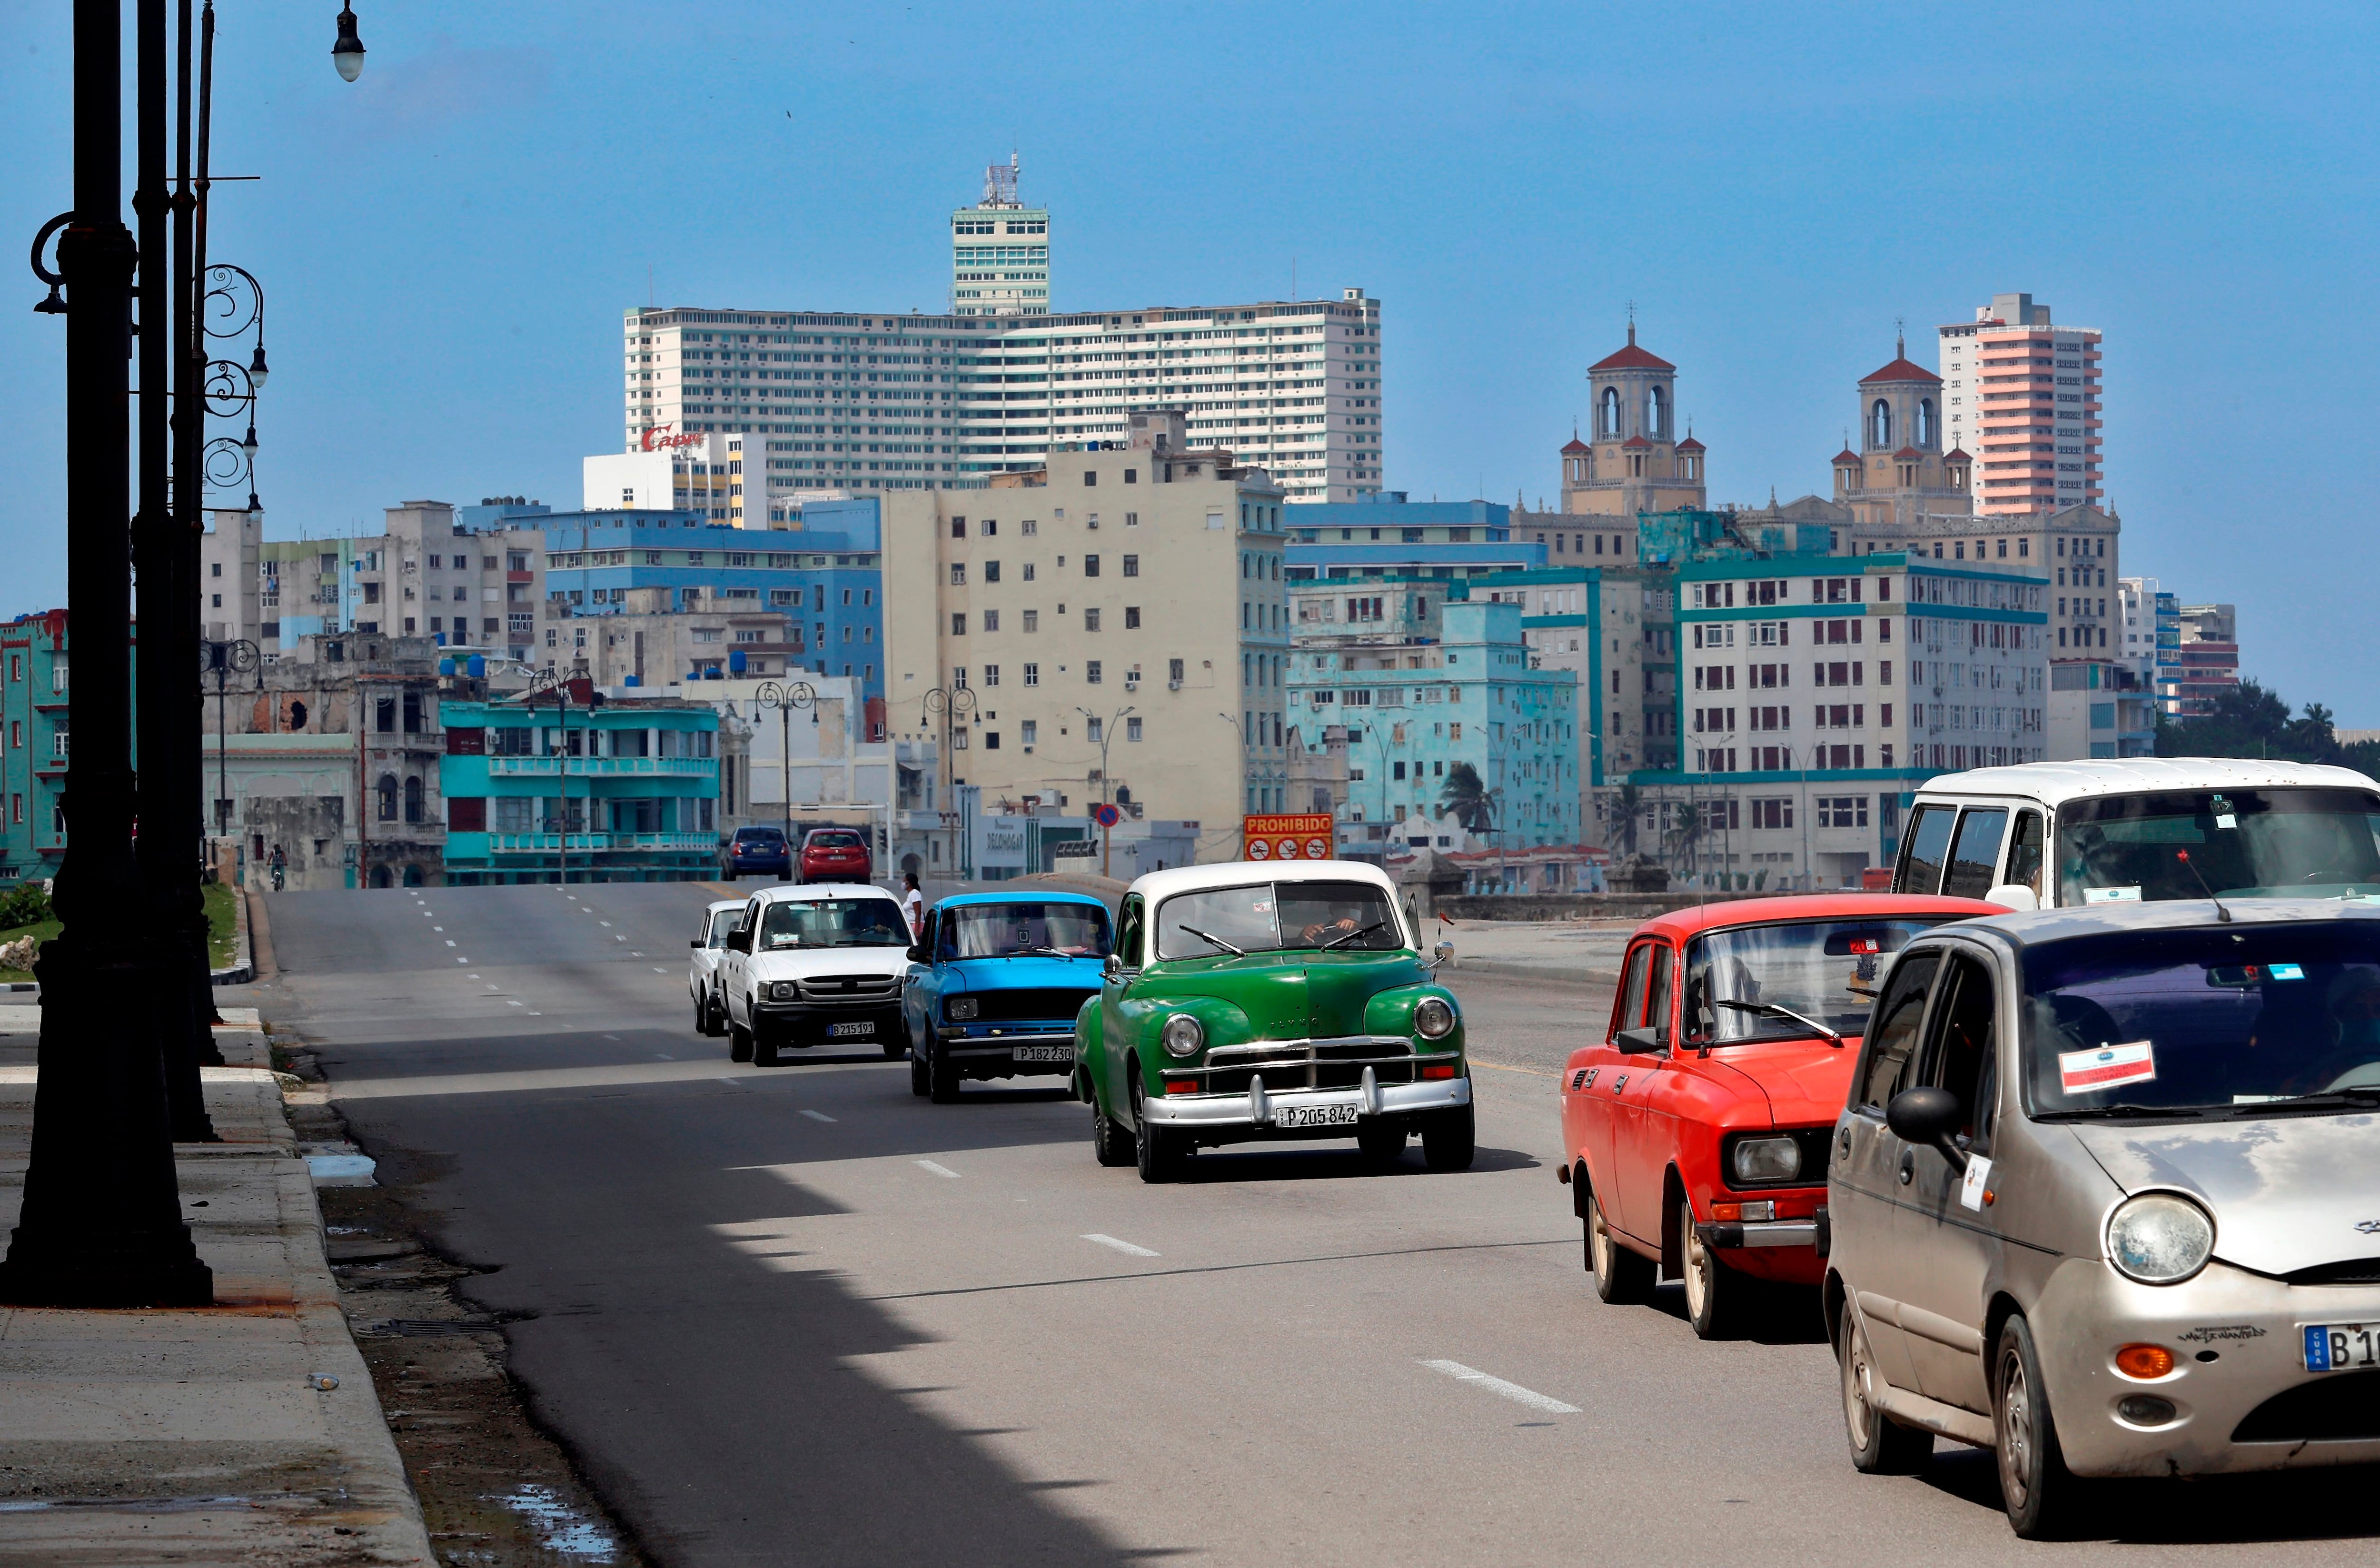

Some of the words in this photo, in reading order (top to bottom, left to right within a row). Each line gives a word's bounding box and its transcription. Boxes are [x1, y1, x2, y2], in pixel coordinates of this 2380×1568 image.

[641, 421, 705, 451] Capri
[1247, 817, 1330, 832] PROHIBIDO
[833, 1026, 839, 1035] B
[840, 1024, 856, 1034] 215
[857, 1023, 873, 1033] 191
[1021, 1048, 1027, 1060] P
[1030, 1048, 1049, 1060] 182
[1051, 1048, 1071, 1060] 230
[1288, 1110, 1296, 1126] P
[1299, 1109, 1326, 1125] 205
[1329, 1106, 1356, 1123] 842
[2313, 1332, 2322, 1365] CUBA
[2330, 1332, 2350, 1366] B
[2357, 1331, 2380, 1365] 1
